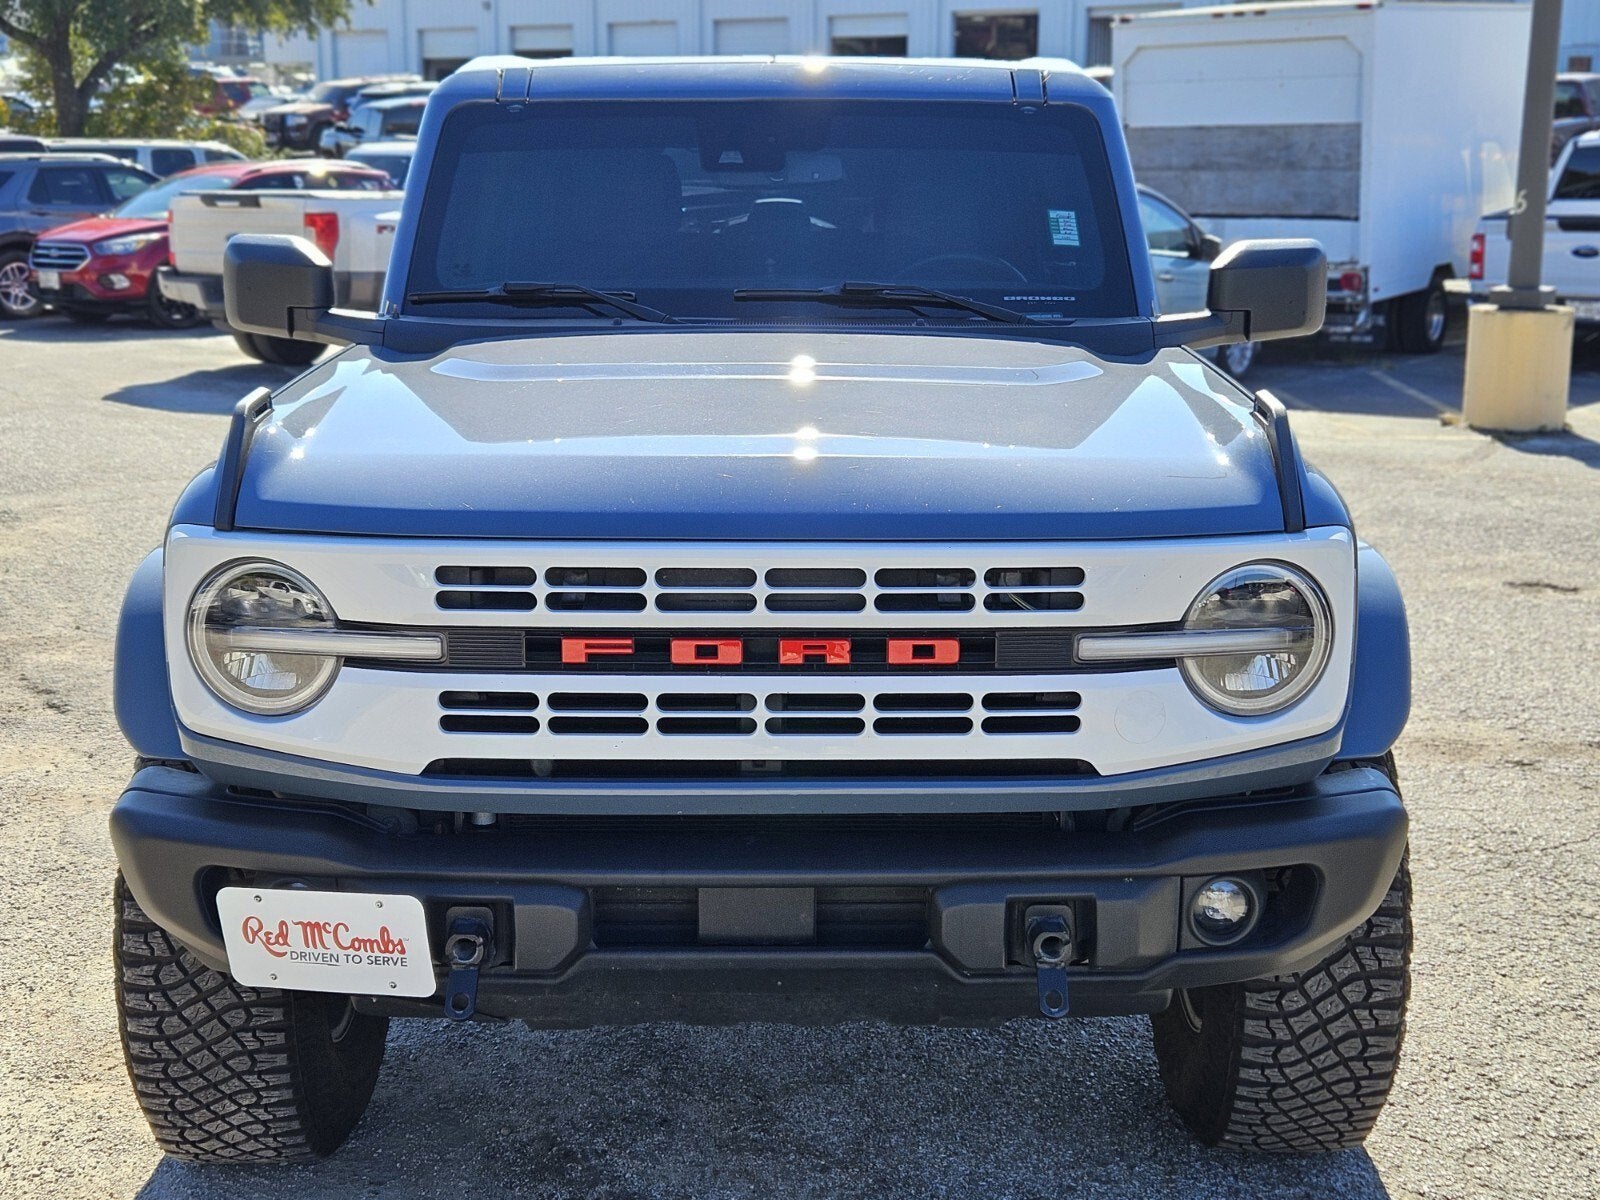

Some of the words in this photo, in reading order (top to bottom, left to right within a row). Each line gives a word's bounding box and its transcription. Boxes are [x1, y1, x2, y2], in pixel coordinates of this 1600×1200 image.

[561, 637, 960, 665] FORD
[241, 916, 291, 957] Red
[292, 919, 407, 955] McCombs
[290, 950, 340, 964] DRIVEN
[343, 953, 363, 965] TO
[366, 955, 408, 967] SERVE
